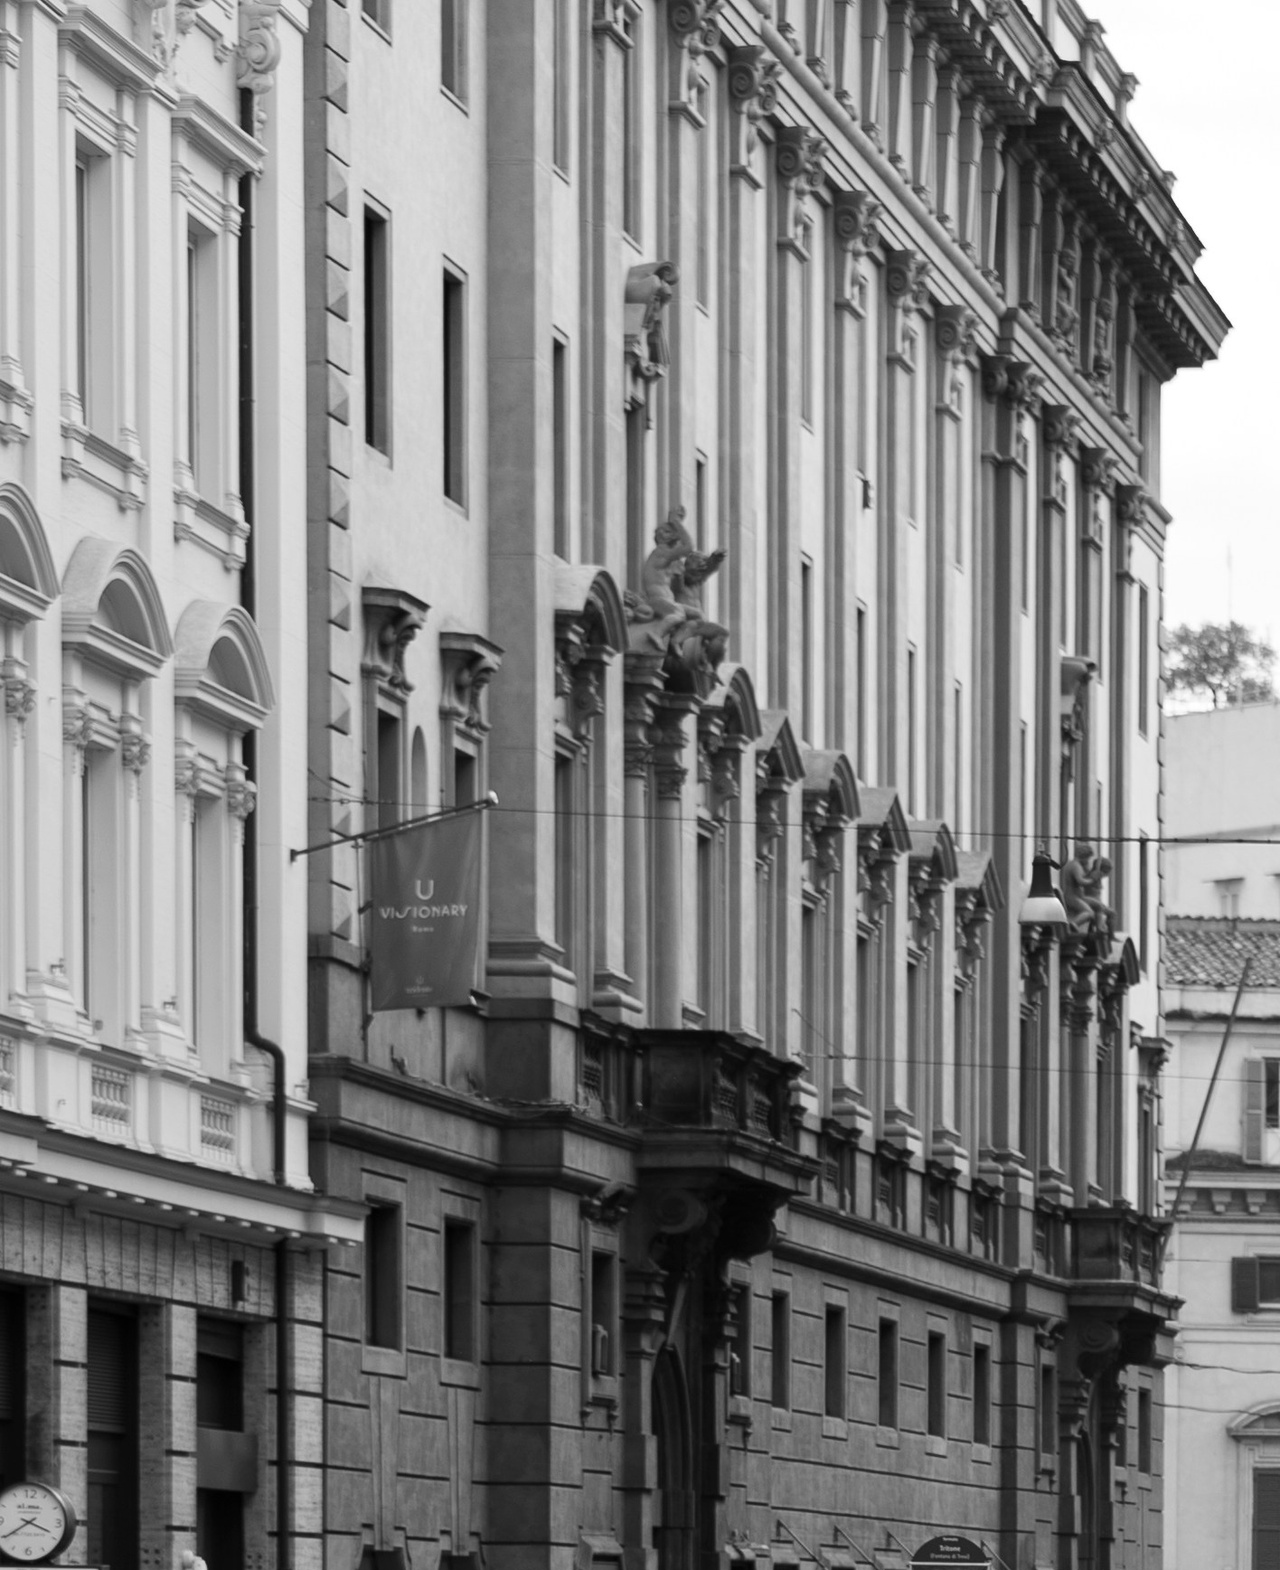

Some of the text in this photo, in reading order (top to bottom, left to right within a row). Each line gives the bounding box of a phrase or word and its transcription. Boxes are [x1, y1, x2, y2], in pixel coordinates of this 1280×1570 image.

[378, 904, 468, 919] VISIONARY
[24, 1489, 37, 1499] 12
[55, 1518, 62, 1528] 3
[24, 1547, 32, 1556] 6
